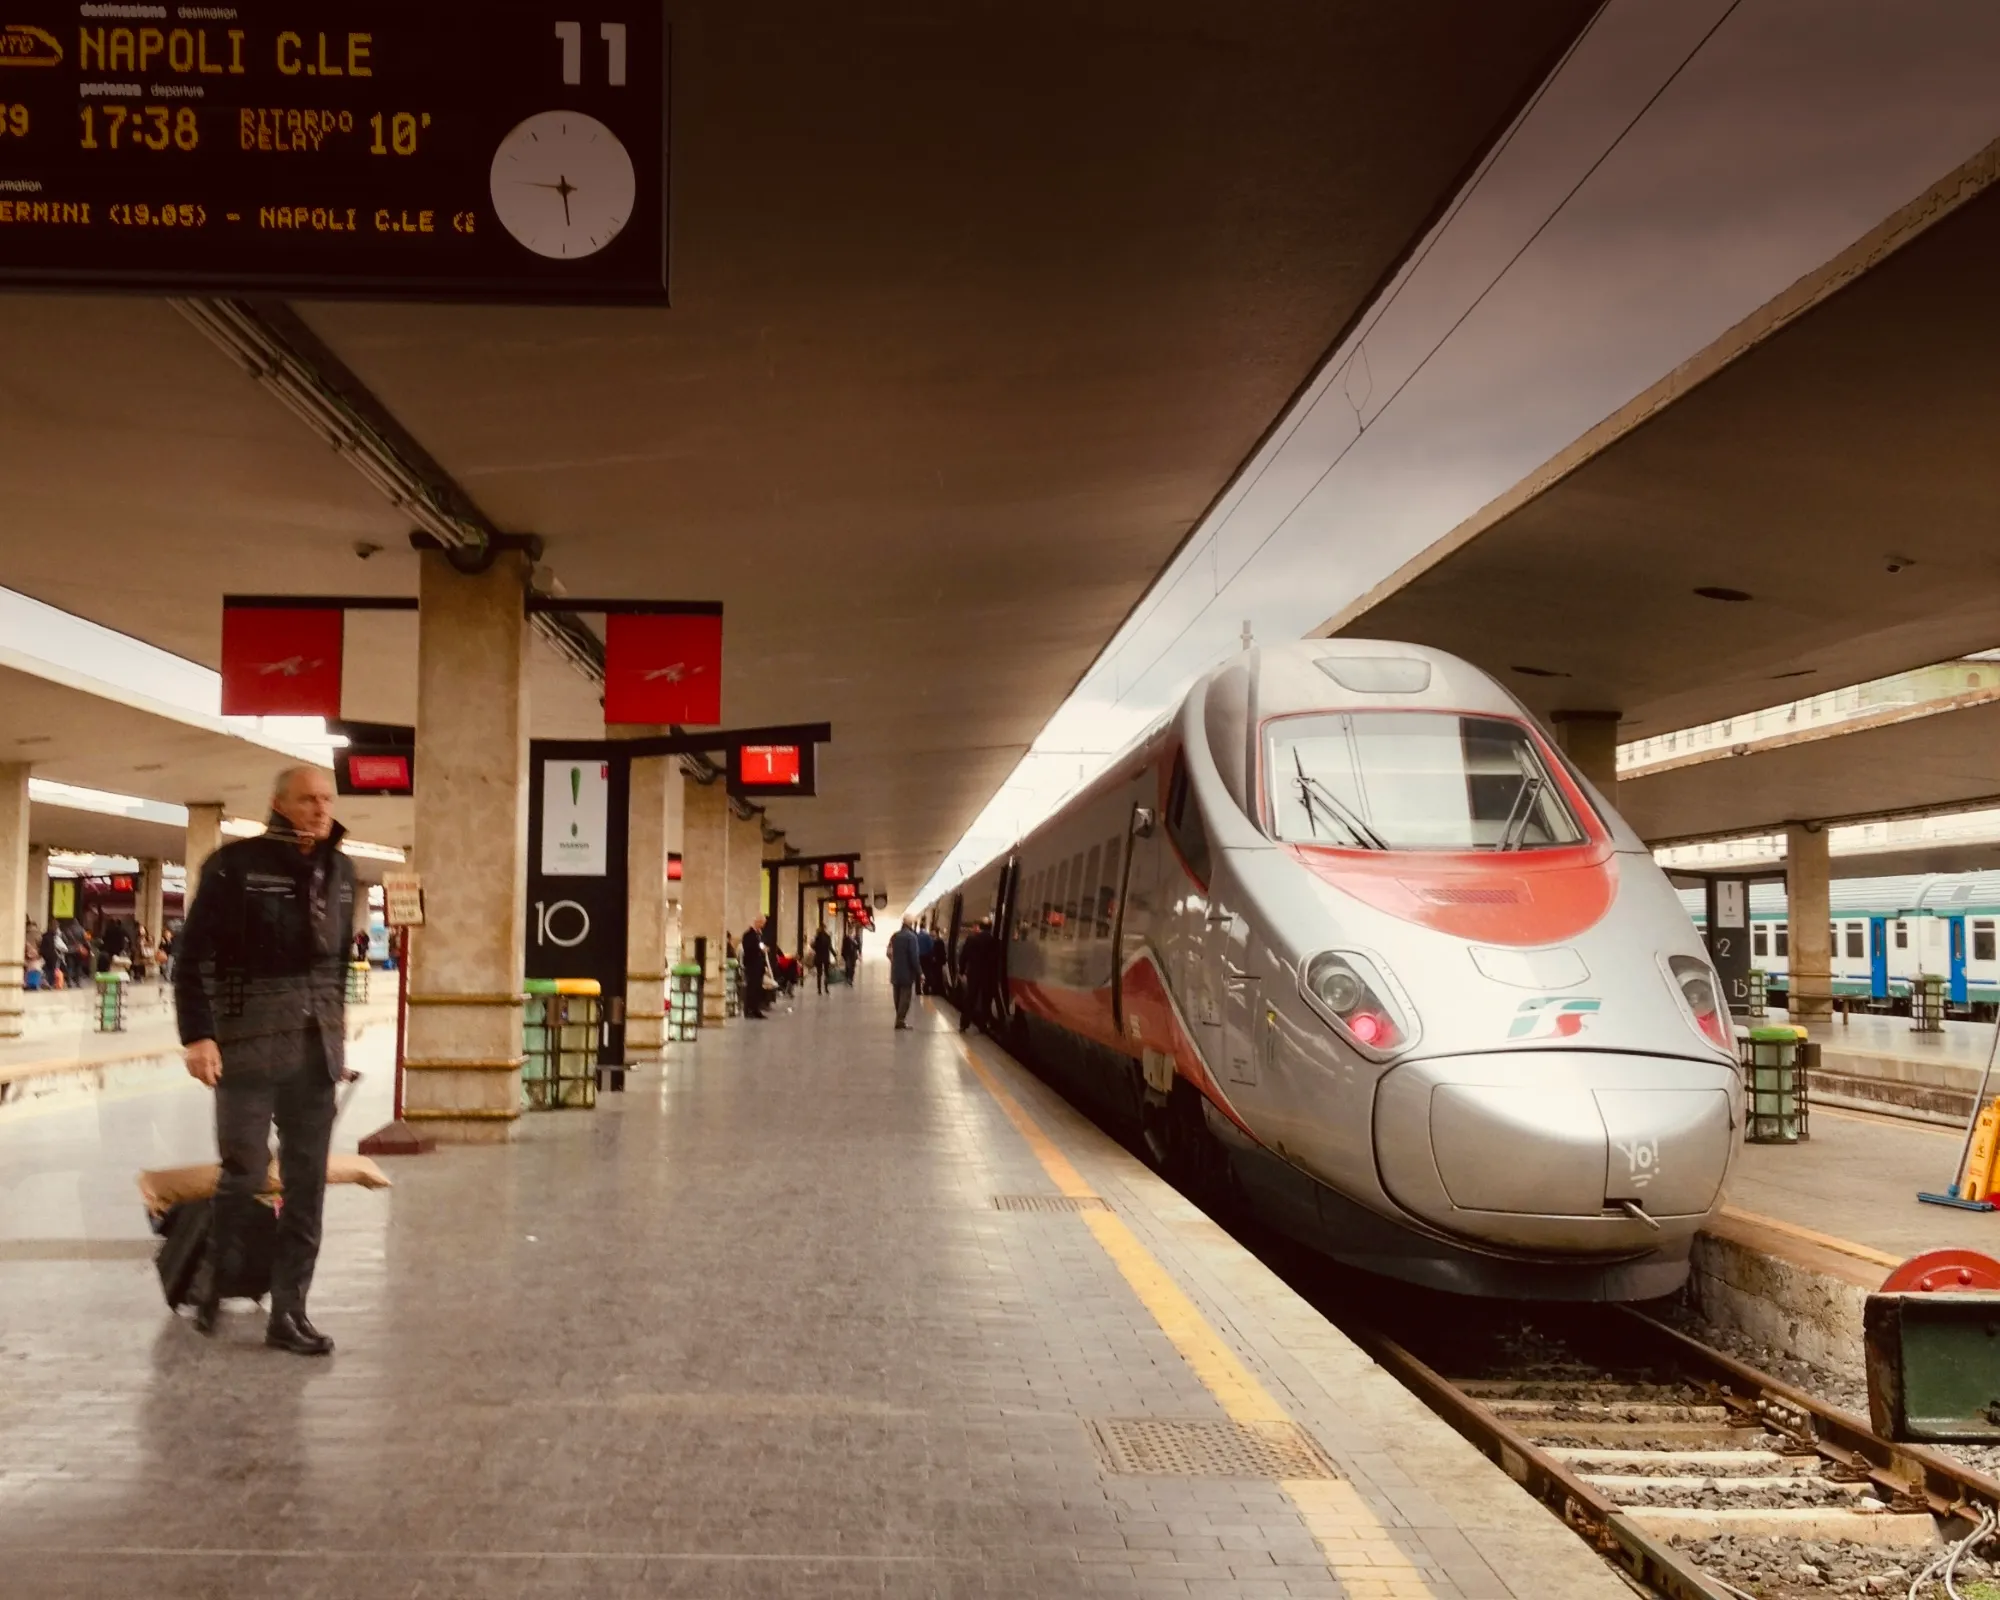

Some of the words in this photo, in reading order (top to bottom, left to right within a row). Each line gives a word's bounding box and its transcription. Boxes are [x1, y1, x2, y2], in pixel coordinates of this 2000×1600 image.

[80, 2, 167, 19] destinazione
[177, 6, 238, 20] destination
[79, 27, 246, 74] NAPOLI
[276, 31, 373, 77] C.LE
[555, 21, 627, 87] 11
[80, 82, 142, 98] partenza
[150, 83, 204, 98] departure
[80, 104, 199, 151] 17:38
[240, 108, 353, 132] RITARDO
[370, 111, 431, 156] 10'
[240, 126, 324, 151] DELAY
[109, 204, 207, 227] (19.05)
[259, 206, 356, 231] NAPOLI
[375, 209, 434, 233] C.LE
[764, 752, 773, 774] 1
[535, 900, 590, 947] 10
